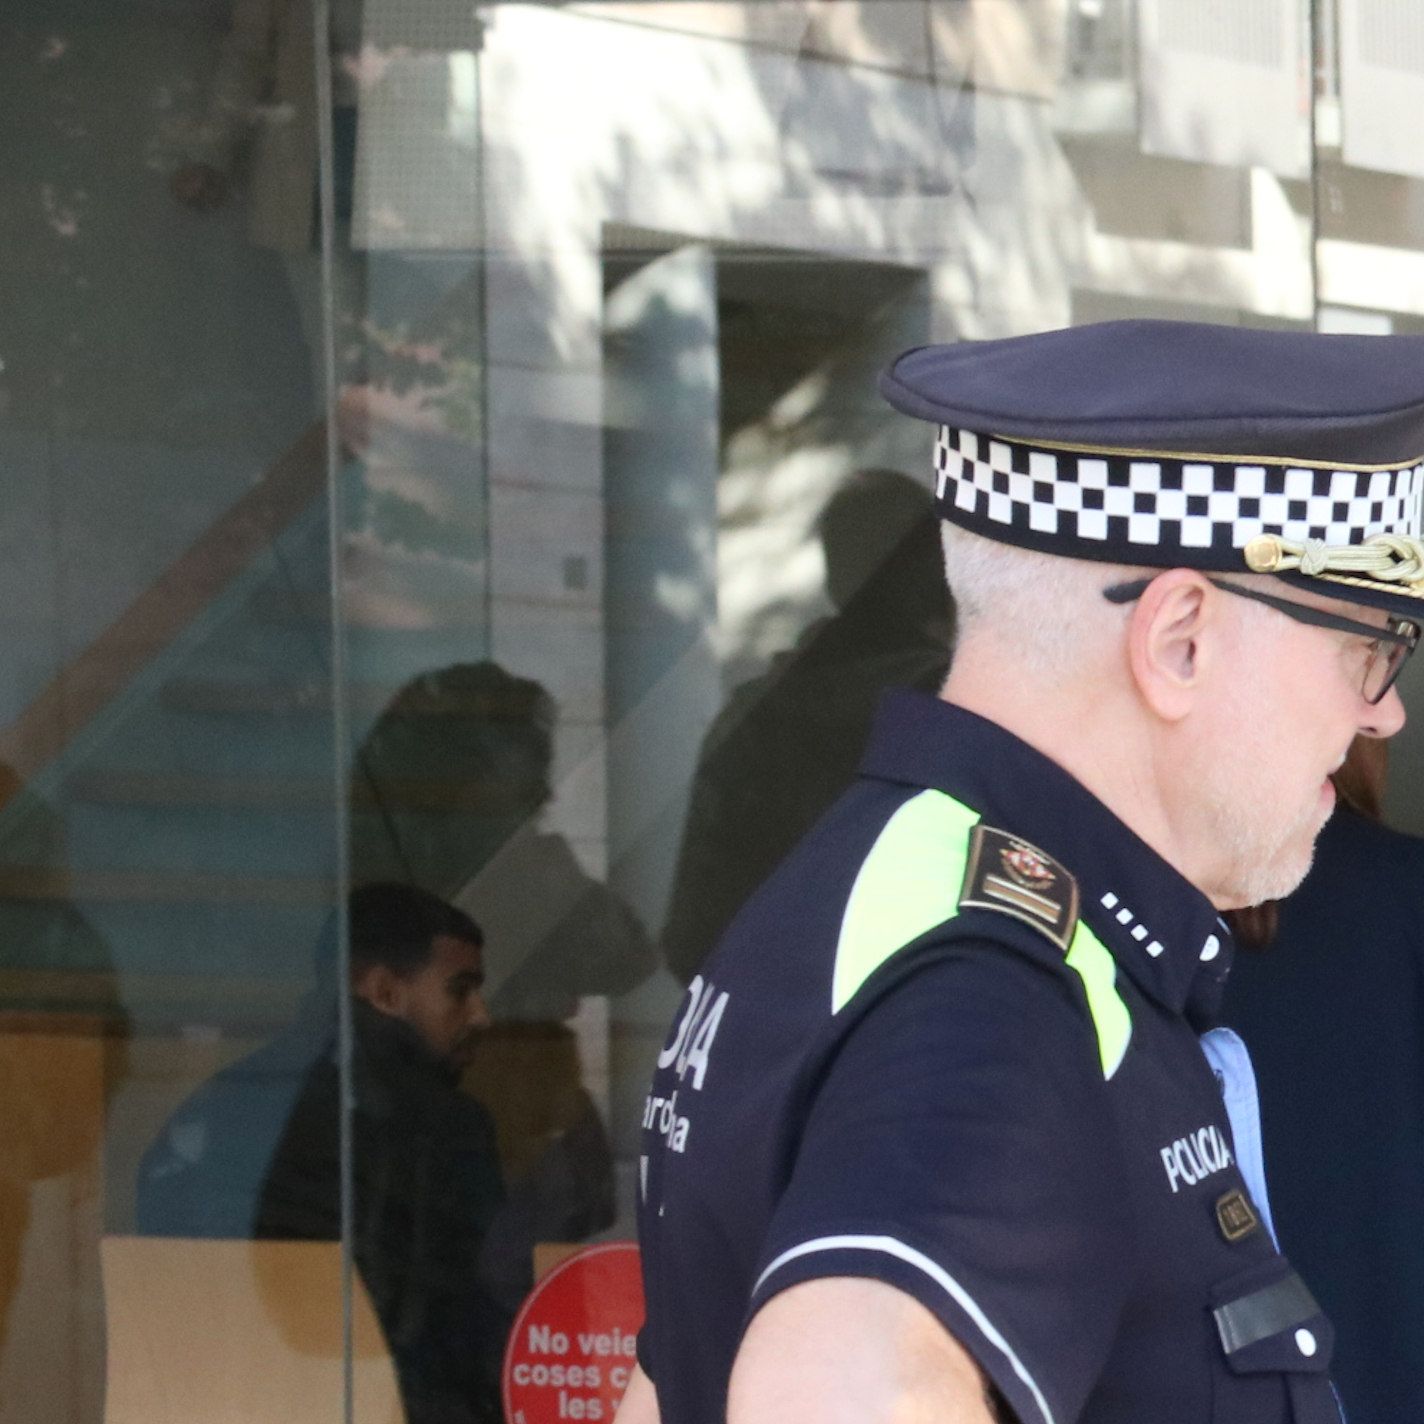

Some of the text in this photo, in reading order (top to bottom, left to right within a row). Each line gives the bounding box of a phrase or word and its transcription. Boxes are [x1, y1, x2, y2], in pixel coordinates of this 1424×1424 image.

[1159, 1124, 1235, 1193] POLICIA
[528, 1324, 570, 1355] No
[513, 1363, 632, 1388] coses c
[558, 1390, 604, 1420] les
